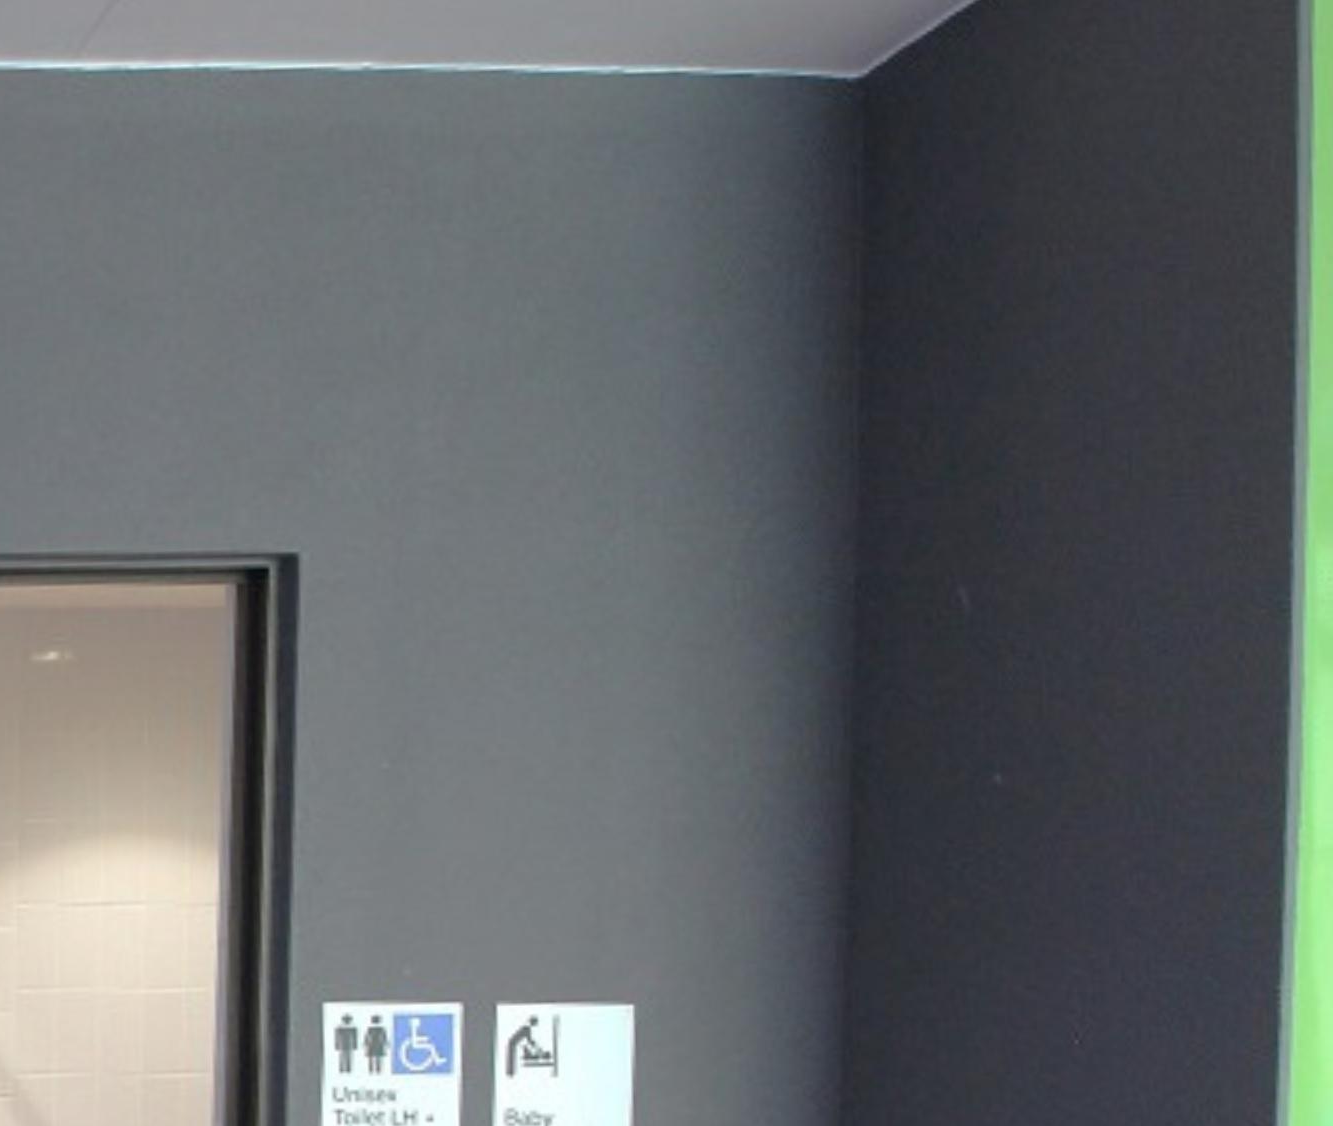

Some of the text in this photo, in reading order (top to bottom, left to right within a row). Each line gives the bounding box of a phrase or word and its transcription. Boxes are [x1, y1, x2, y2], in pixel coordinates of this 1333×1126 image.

[332, 1086, 397, 1104] Unisex
[332, 1107, 386, 1126] Toilet
[391, 1108, 419, 1126] LH
